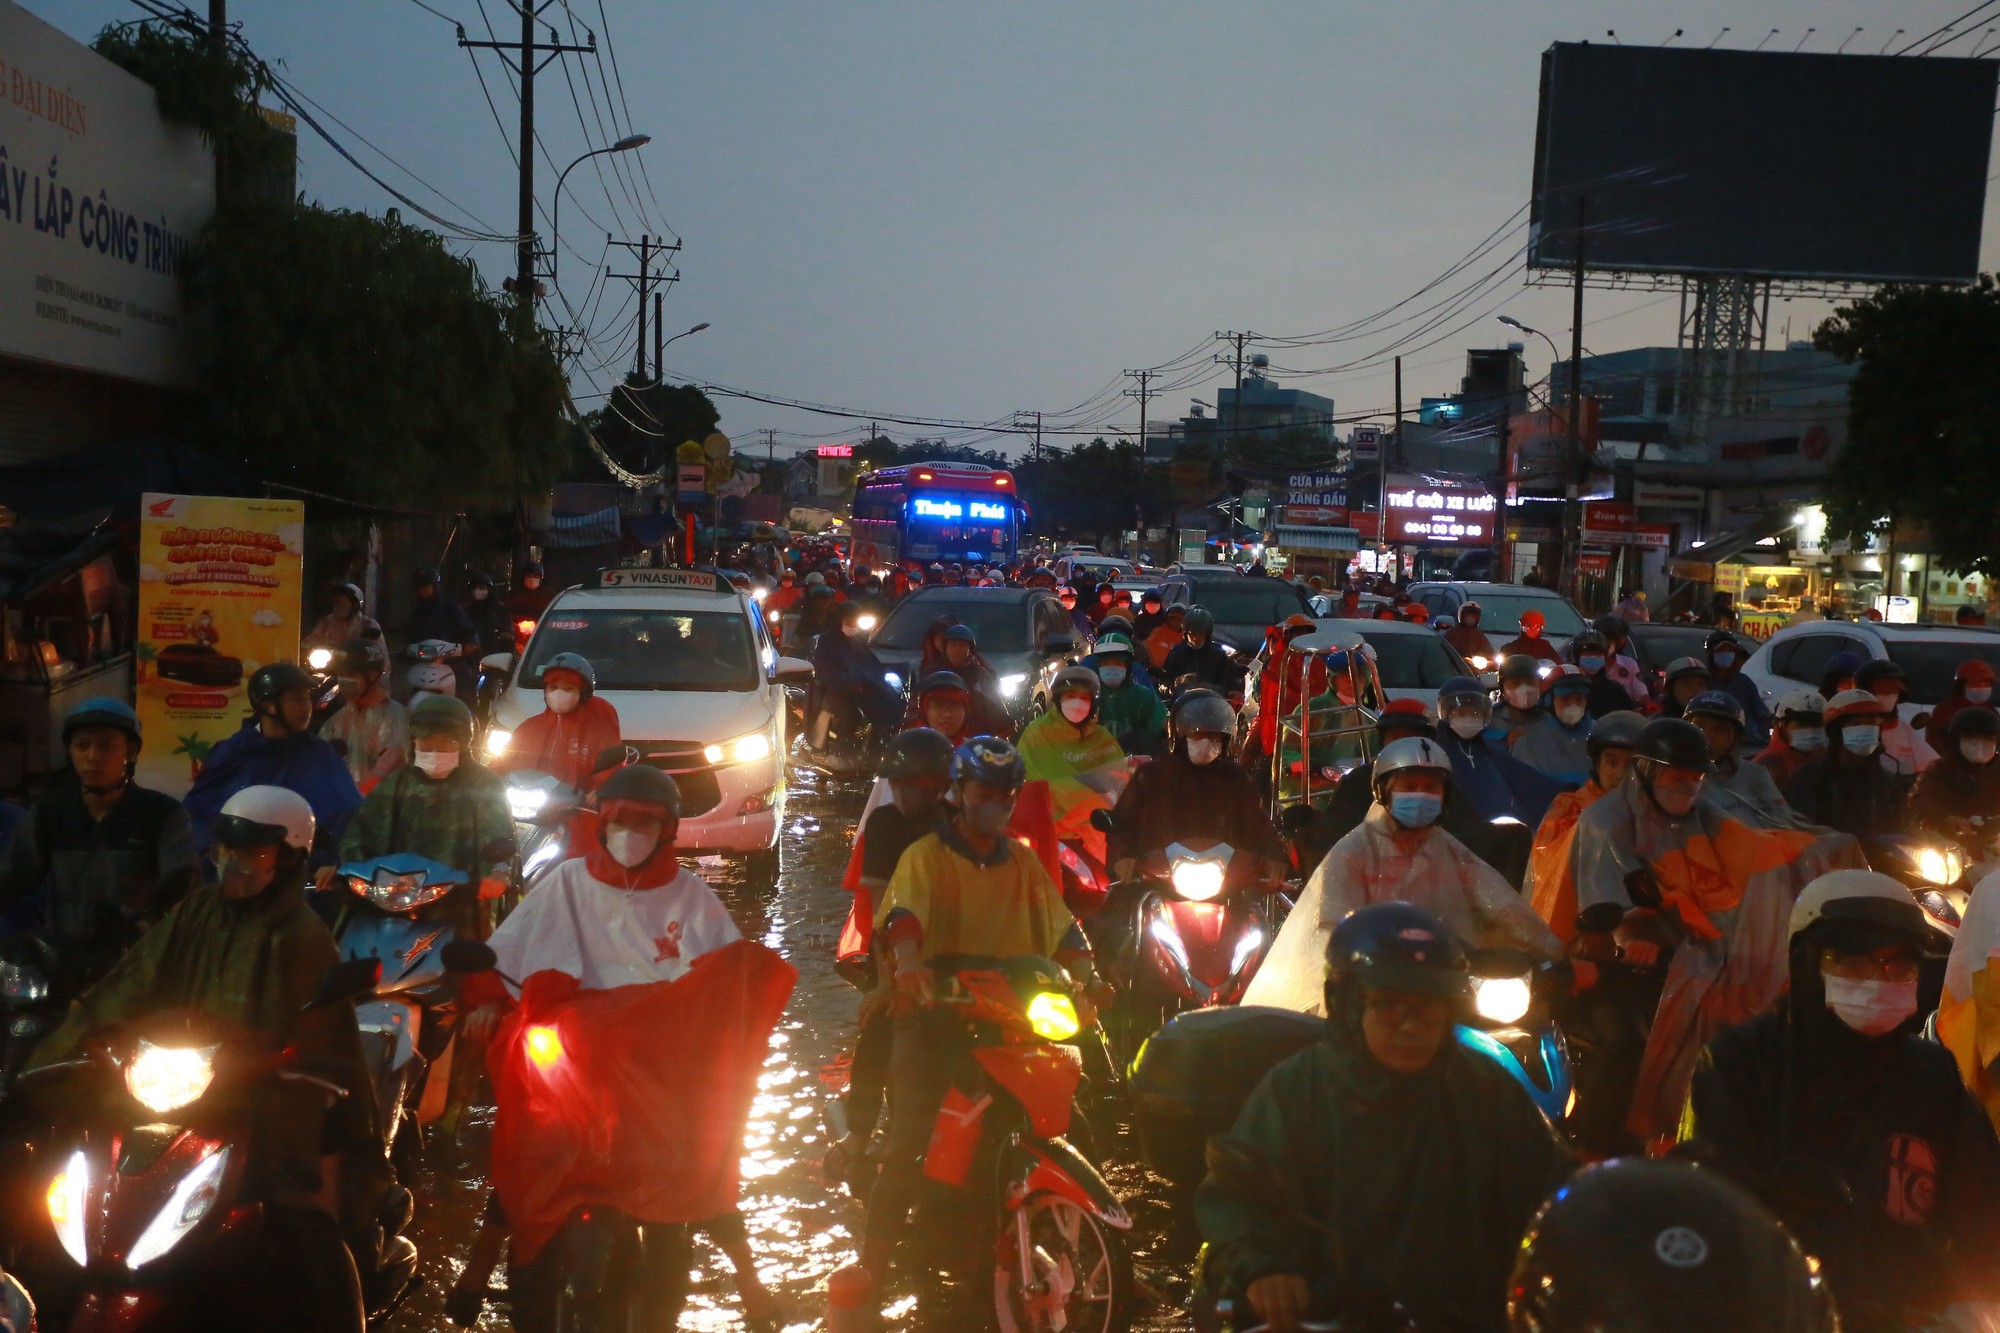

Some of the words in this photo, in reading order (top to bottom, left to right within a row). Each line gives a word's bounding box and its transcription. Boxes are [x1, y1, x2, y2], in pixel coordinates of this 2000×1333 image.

[11, 67, 42, 121] ĐẠI
[47, 85, 86, 139] DIỆN
[34, 154, 73, 239] LẮP
[80, 188, 138, 264] CÔNG
[1315, 475, 1347, 487] HÀN
